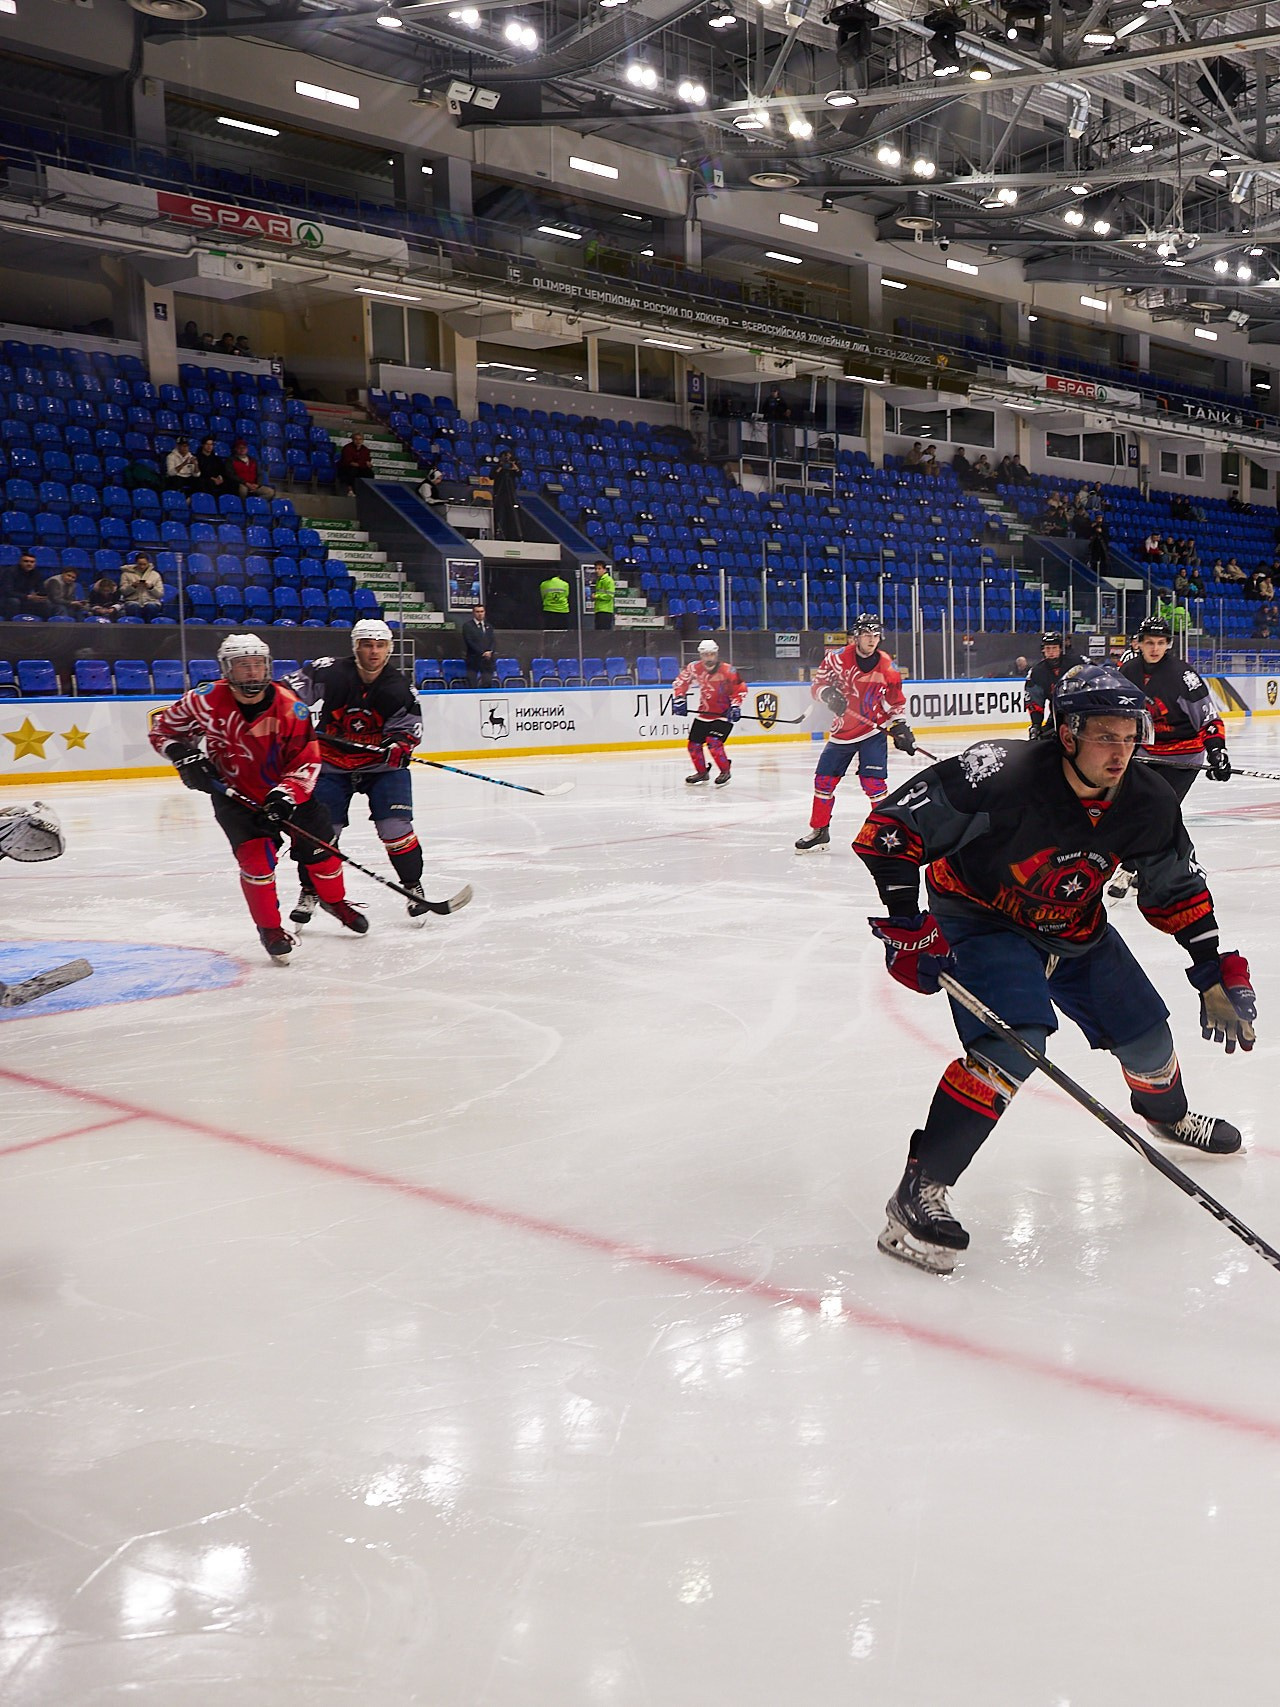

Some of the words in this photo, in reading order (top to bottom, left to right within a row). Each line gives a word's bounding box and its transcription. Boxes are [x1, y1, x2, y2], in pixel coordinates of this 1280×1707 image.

[190, 203, 290, 238] SPAR
[532, 277, 583, 297] OLIMPBET
[584, 287, 641, 308] ЧЕМПИОНАТ
[643, 300, 679, 315] РОССИИ
[680, 308, 693, 318] ПО
[695, 311, 730, 326] ХОККЕЮ
[272, 363, 281, 373] 5
[692, 377, 700, 391] 9
[1057, 381, 1096, 397] SPAR
[1183, 403, 1231, 424] TANK
[1129, 447, 1138, 459] 10
[515, 704, 565, 718] НИЖНИЙ
[515, 718, 576, 732] НОВГОРОД
[897, 781, 932, 811] 31
